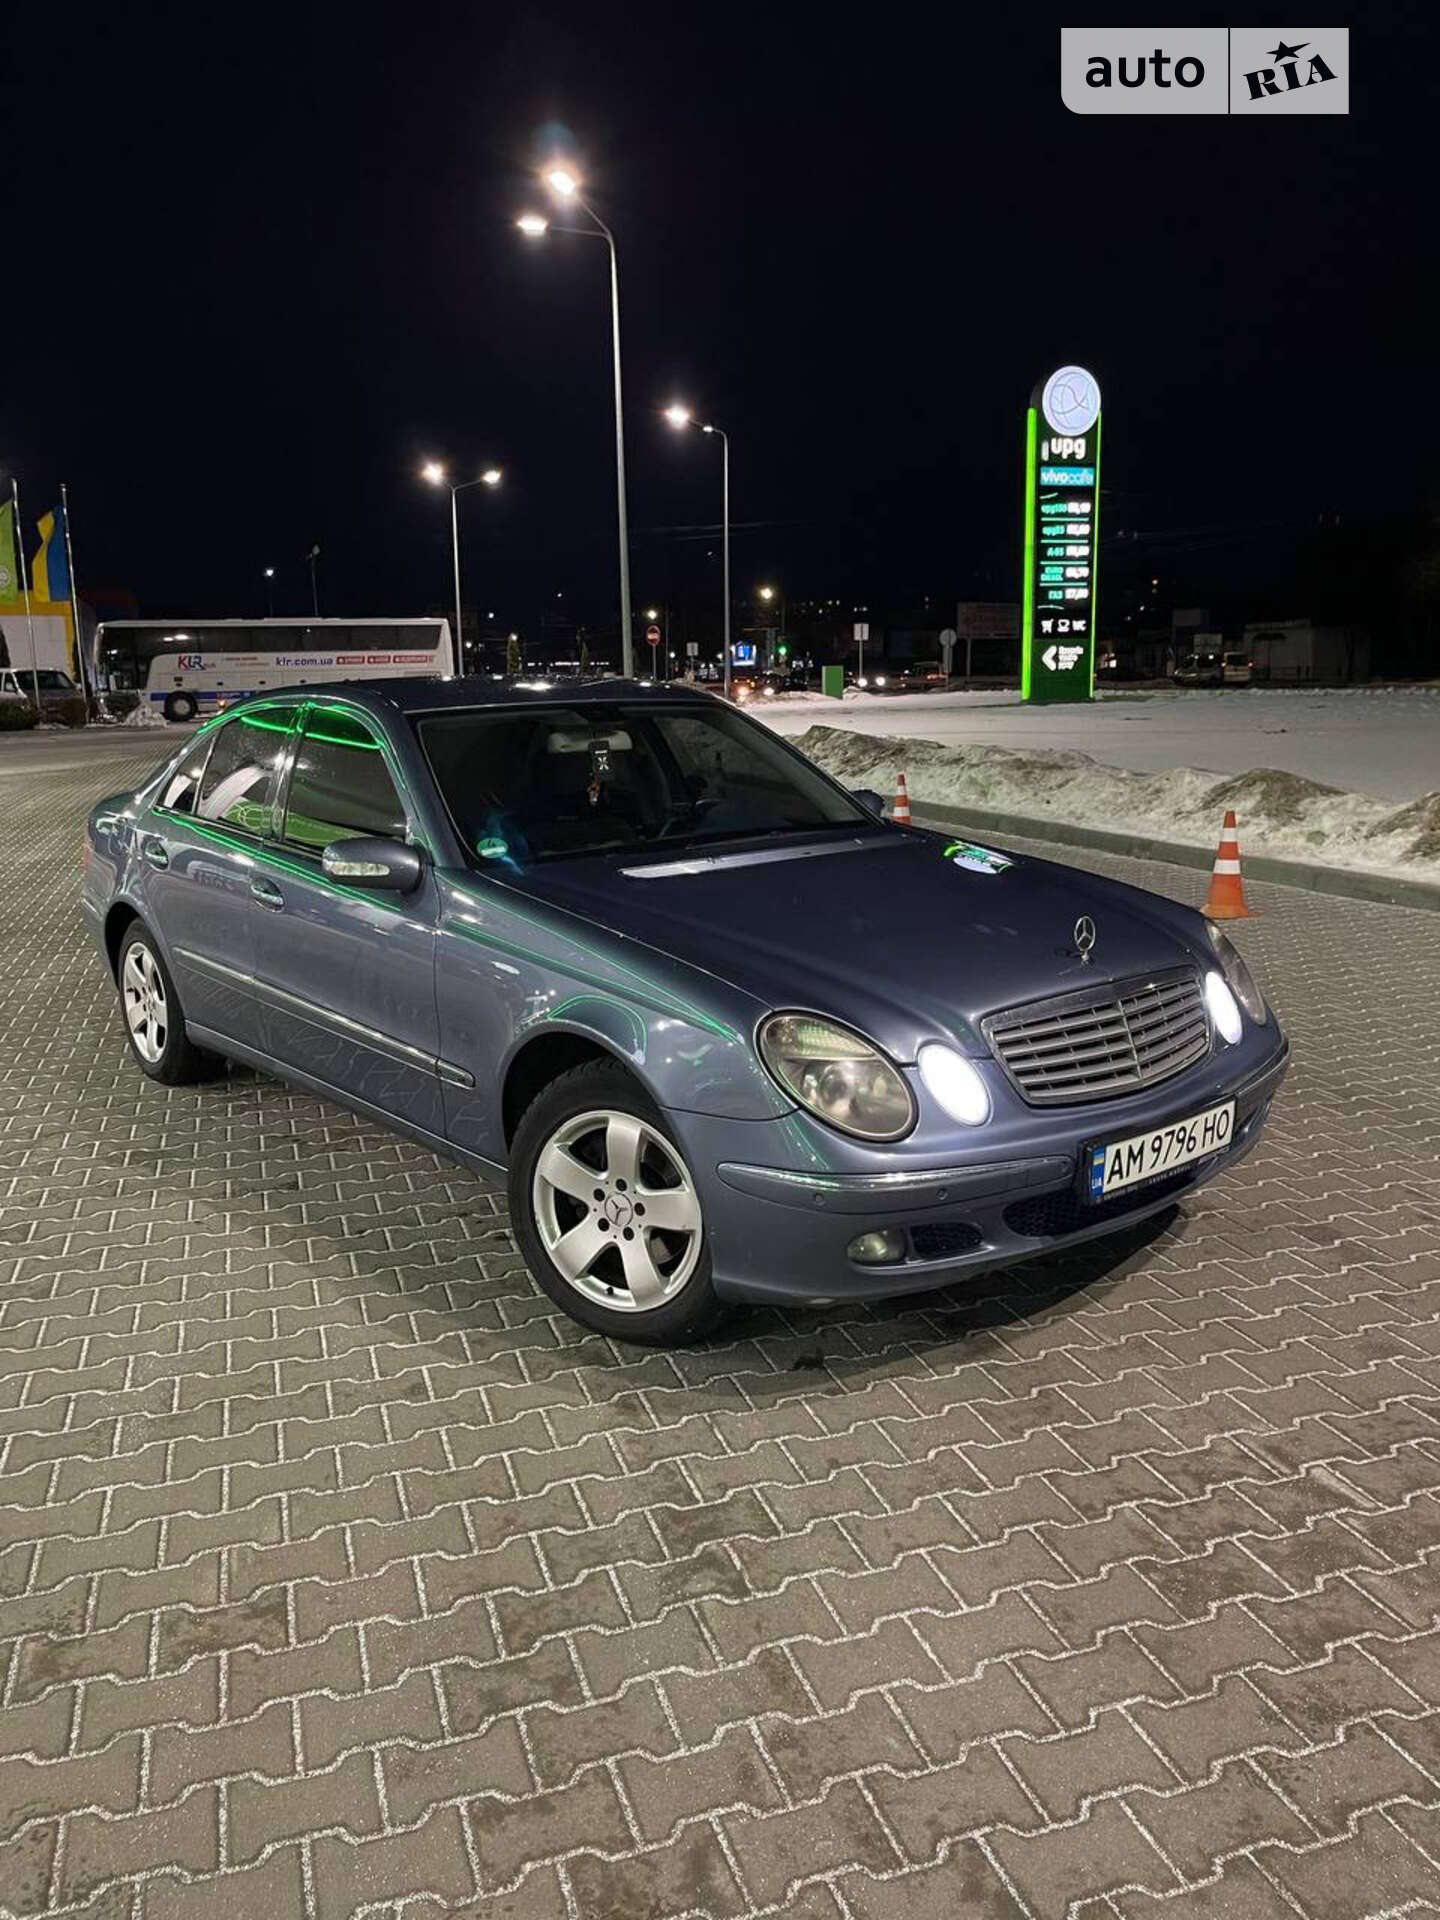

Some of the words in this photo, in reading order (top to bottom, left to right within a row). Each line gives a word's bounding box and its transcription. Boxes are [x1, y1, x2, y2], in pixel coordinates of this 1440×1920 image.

[1051, 437, 1086, 460] upg
[1072, 620, 1086, 631] WC
[178, 655, 205, 671] KLR
[276, 655, 333, 667] klr.com.ua
[1106, 1140, 1145, 1185] AM
[1150, 1120, 1198, 1169] 9796
[1202, 1109, 1230, 1149] HO
